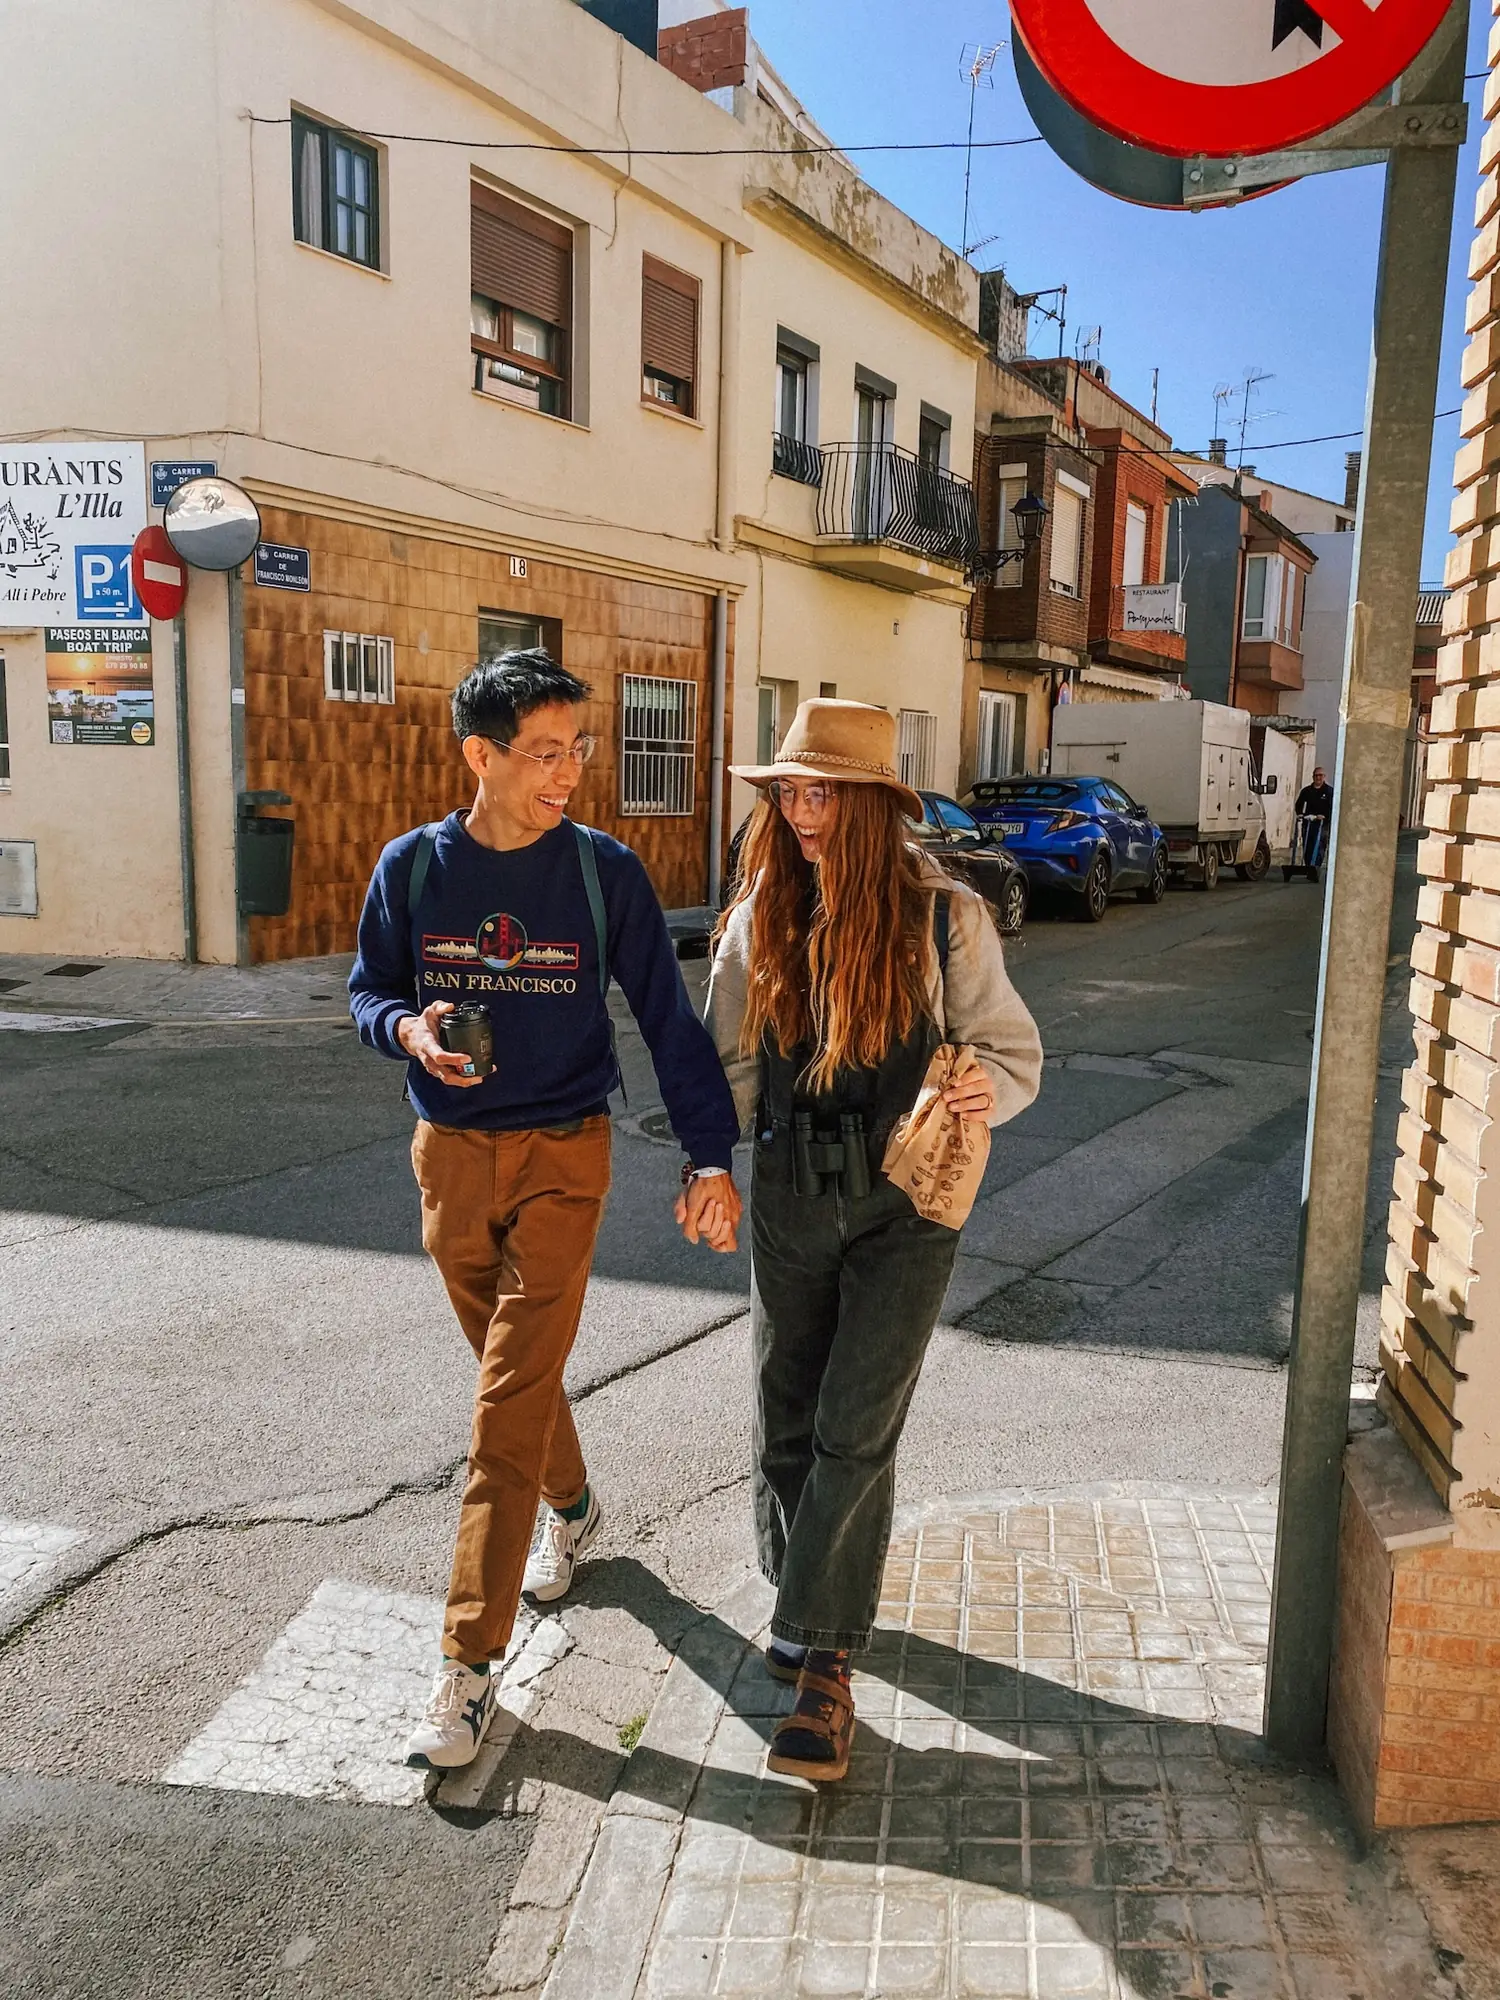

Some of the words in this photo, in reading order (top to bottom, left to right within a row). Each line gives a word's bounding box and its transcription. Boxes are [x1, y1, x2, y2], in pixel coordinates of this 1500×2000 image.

[55, 493, 123, 518] L'Illa
[273, 551, 299, 561] CARRER
[278, 563, 287, 571] DE
[512, 557, 526, 576] 18
[82, 554, 114, 599] P
[257, 570, 285, 581] FRANCISCO
[2, 588, 20, 601] All
[23, 588, 28, 601] i
[31, 588, 67, 601] Pebre
[101, 587, 111, 596] 50
[50, 629, 92, 640] PASEOS
[94, 629, 109, 641] EN
[112, 630, 149, 641] BARCA
[66, 642, 100, 652] BOAT
[103, 642, 133, 652] TRIP
[424, 971, 460, 988] SAN
[466, 974, 577, 994] FRANCISCO
